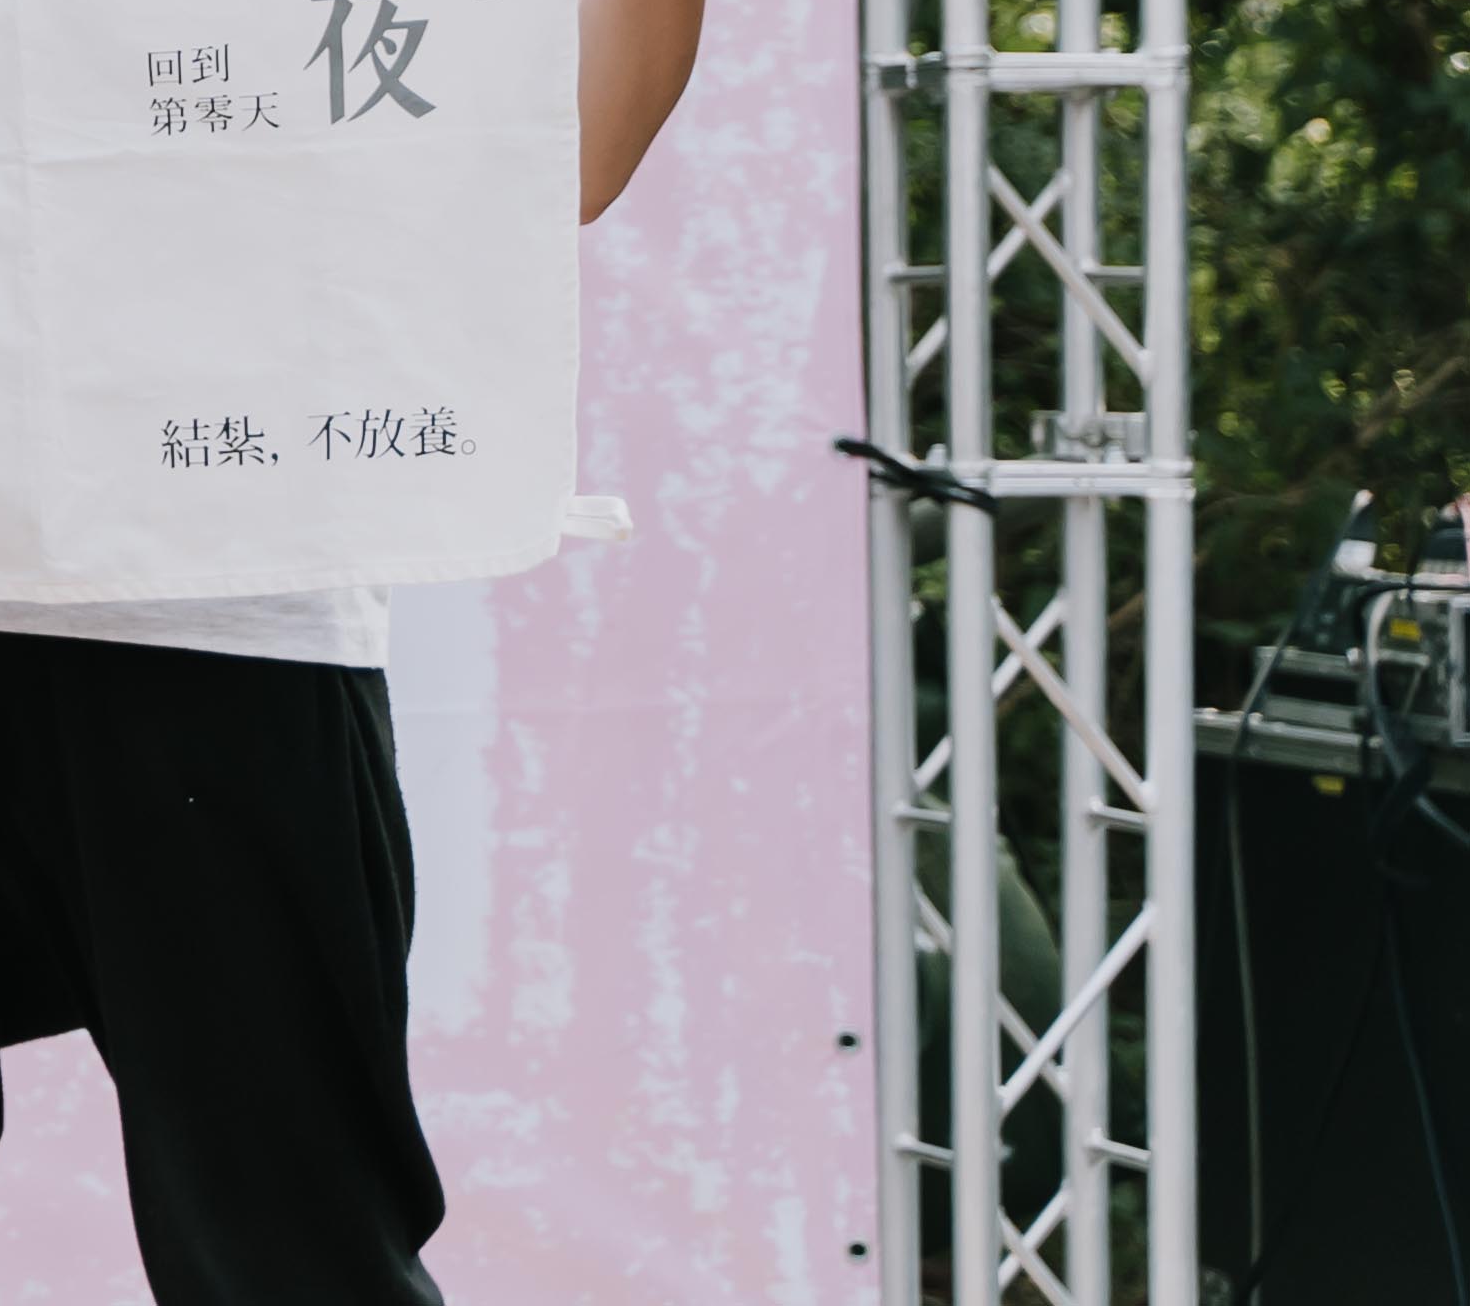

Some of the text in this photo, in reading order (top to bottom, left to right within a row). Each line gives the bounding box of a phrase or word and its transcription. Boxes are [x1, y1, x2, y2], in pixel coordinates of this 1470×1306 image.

[147, 43, 230, 87] 回到
[148, 91, 281, 137] 第零天
